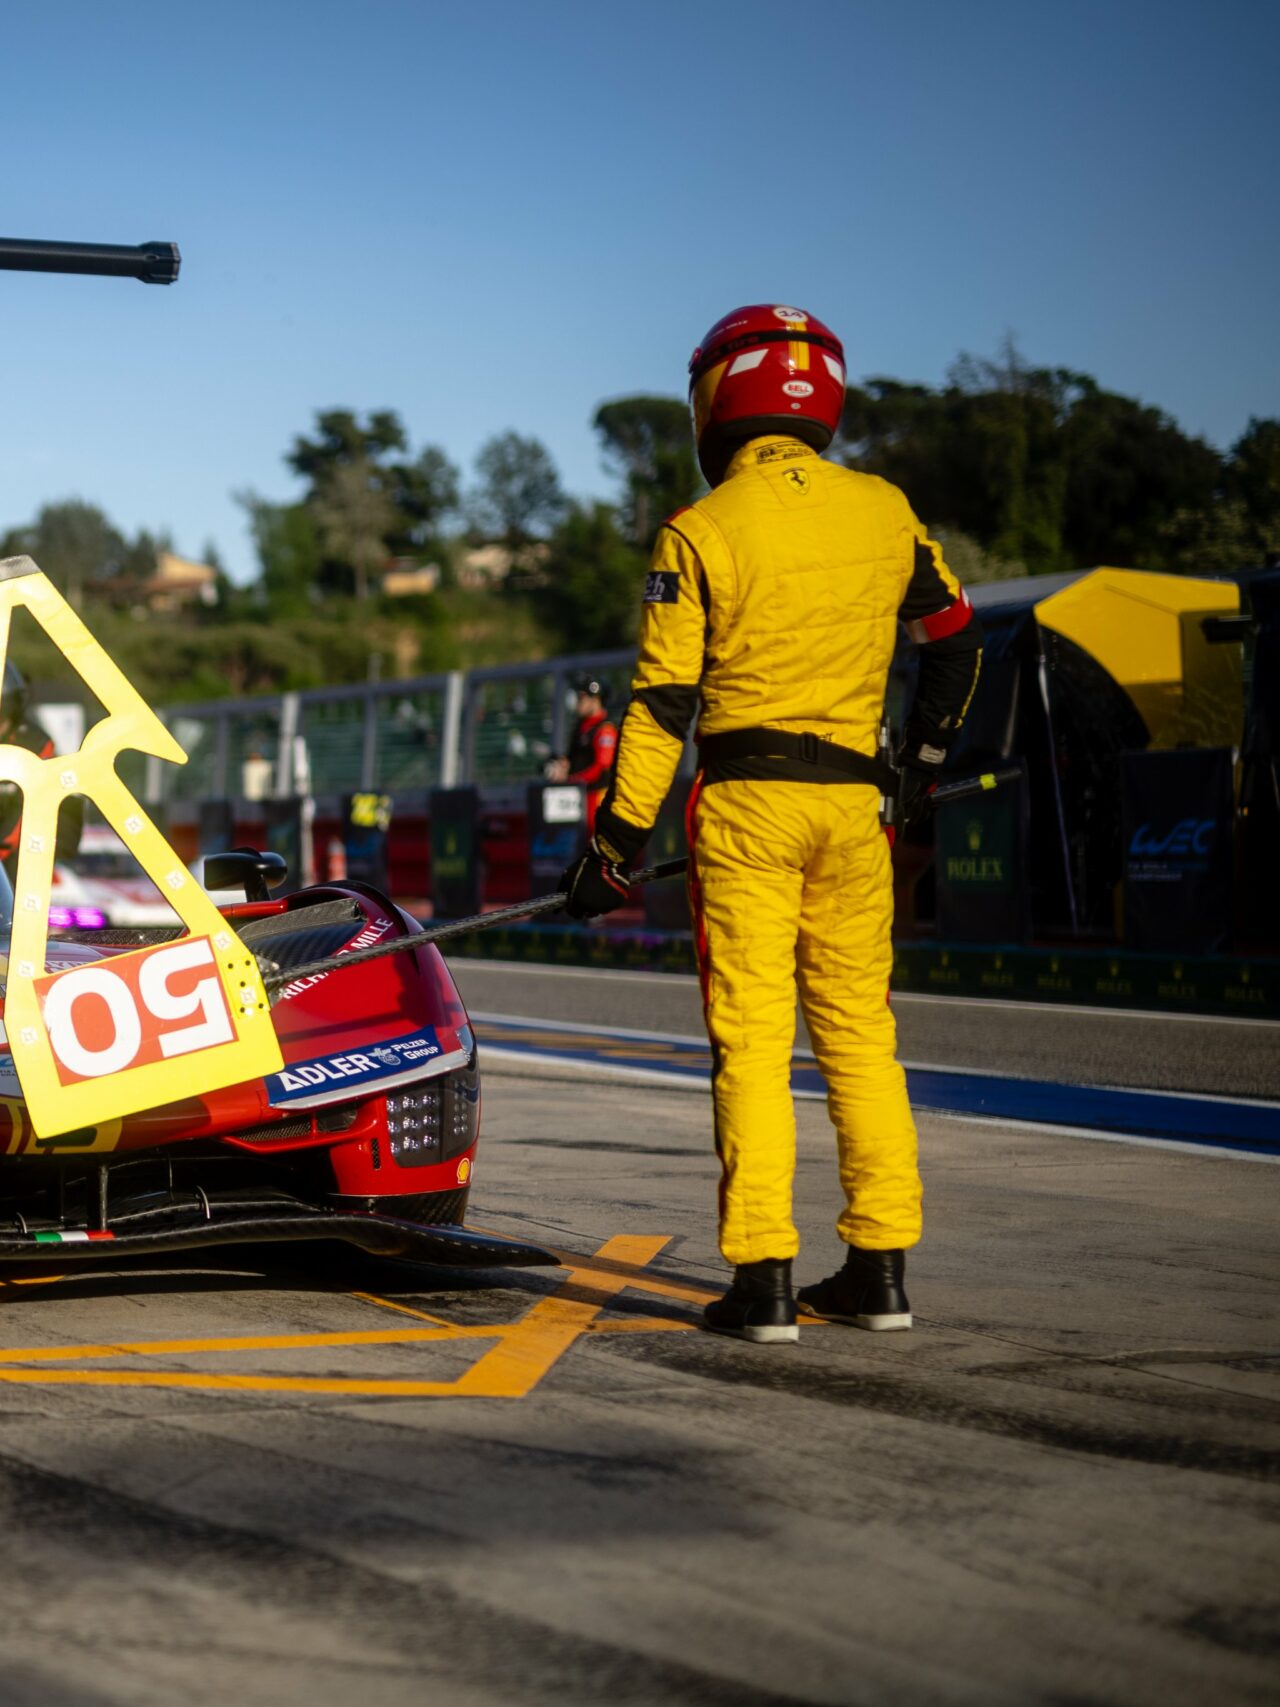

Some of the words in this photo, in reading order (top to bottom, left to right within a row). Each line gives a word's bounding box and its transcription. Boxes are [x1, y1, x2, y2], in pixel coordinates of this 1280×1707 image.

[788, 383, 810, 393] BELL
[947, 857, 1003, 880] ROLEX
[352, 917, 394, 951] MILLE
[44, 938, 235, 1077] 50
[390, 1038, 429, 1053] PELZER
[403, 1045, 439, 1060] GROUP
[275, 1054, 381, 1092] ADLER
